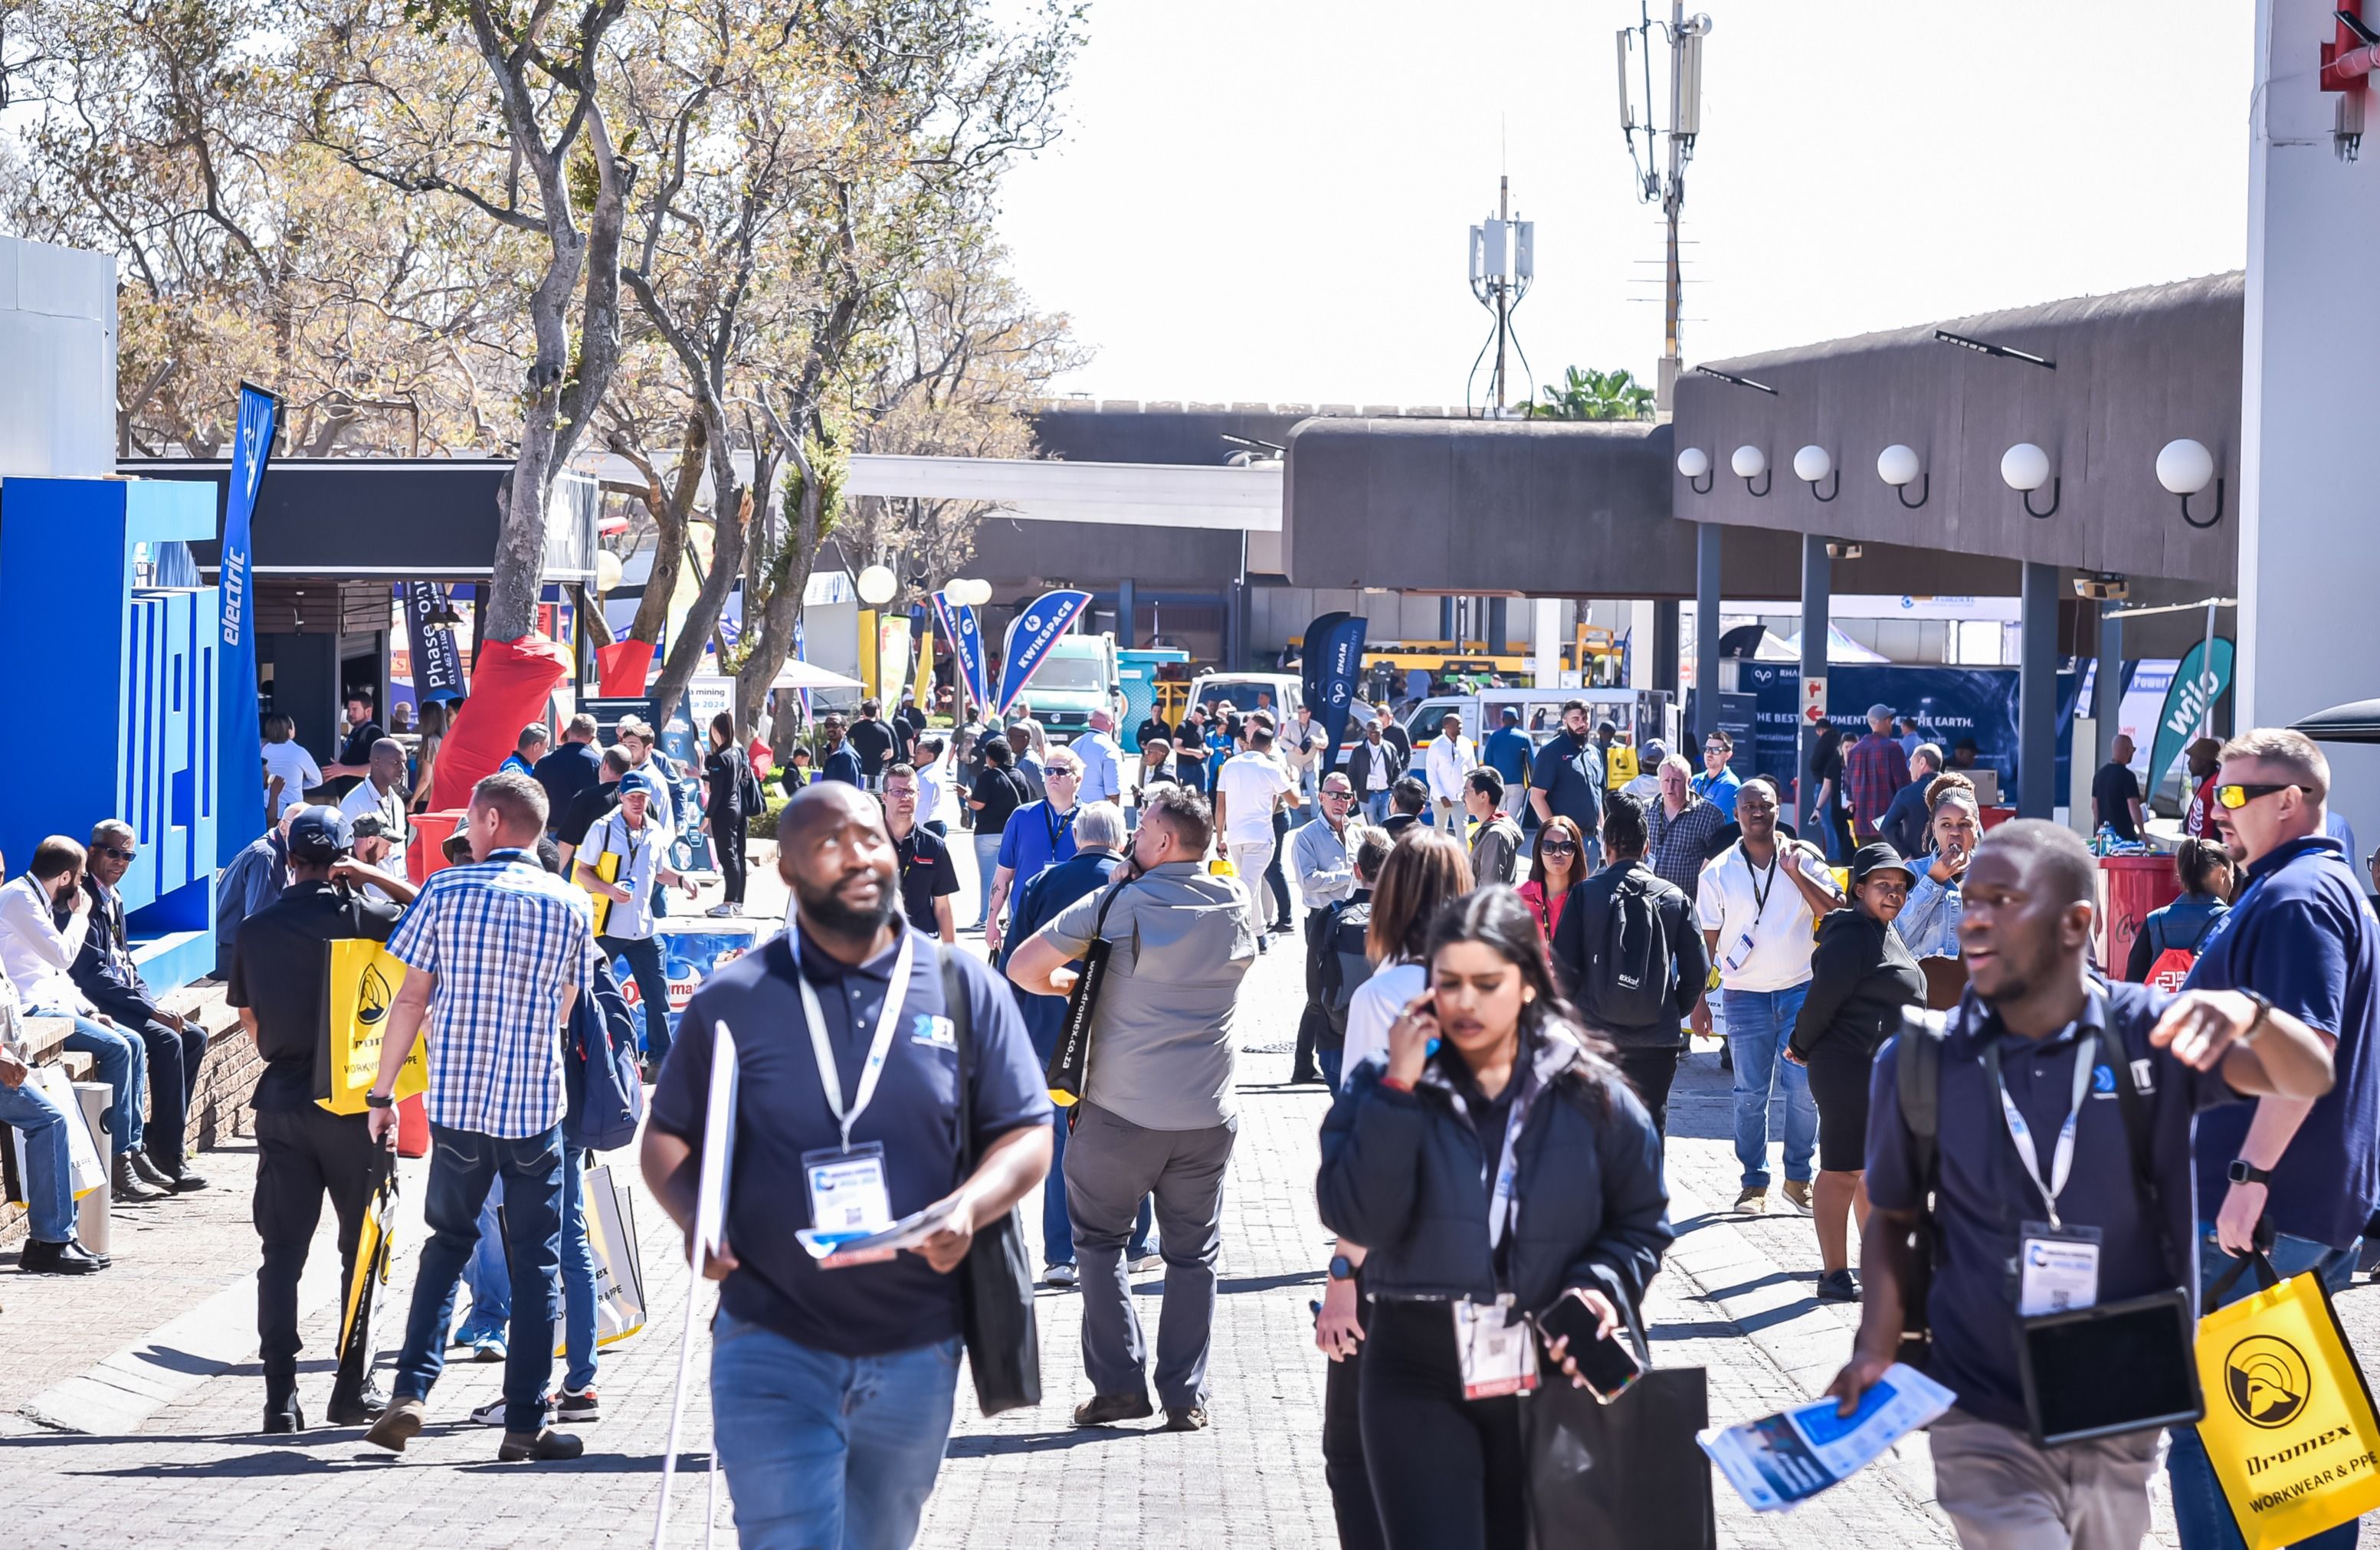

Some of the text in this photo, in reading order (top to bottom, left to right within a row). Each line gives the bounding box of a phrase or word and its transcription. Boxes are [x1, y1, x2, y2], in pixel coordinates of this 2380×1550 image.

[221, 546, 245, 646] electric
[943, 604, 974, 670] KWIPACE
[1018, 601, 1074, 668] KWIKSPACE
[1336, 643, 1348, 674] RHAM
[1345, 630, 1358, 677] EQUIPMENT
[696, 688, 725, 697] mining
[1775, 713, 1799, 723] BEST
[1063, 960, 1096, 1070] www.dromex.co.za
[2245, 1424, 2352, 1476] Dromex
[2248, 1450, 2378, 1513] WORKWEAR & PPE
